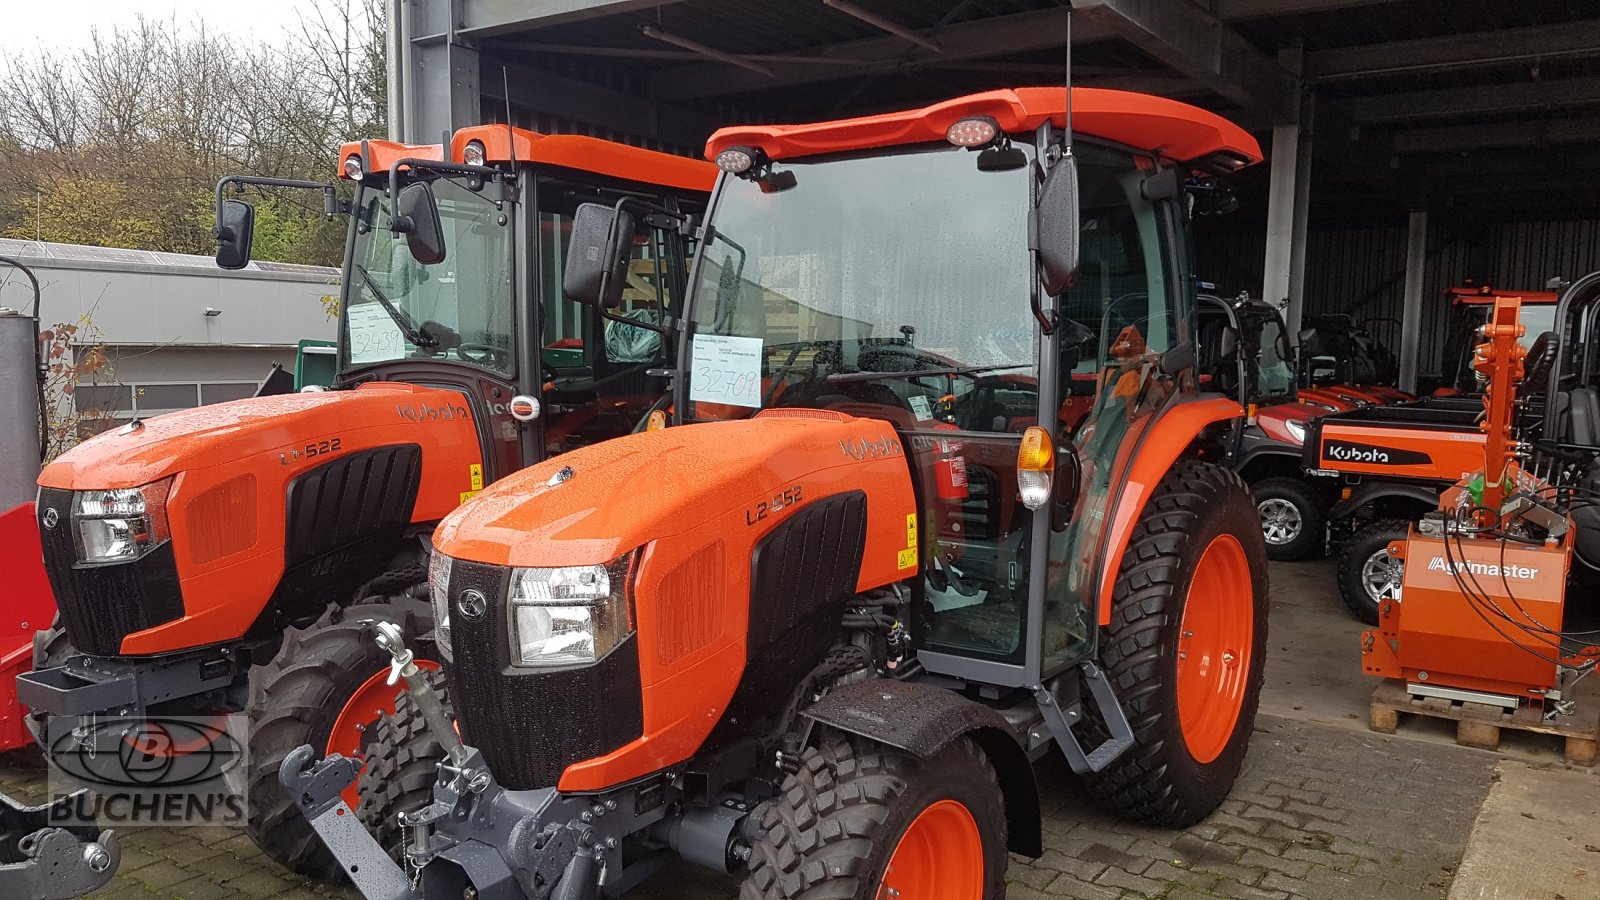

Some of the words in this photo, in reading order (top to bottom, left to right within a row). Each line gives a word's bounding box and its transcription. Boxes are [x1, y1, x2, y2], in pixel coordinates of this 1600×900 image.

[396, 403, 468, 422] Kubota
[838, 434, 902, 461] Kubota
[1329, 446, 1389, 463] Kubota
[745, 485, 803, 526] L2-552
